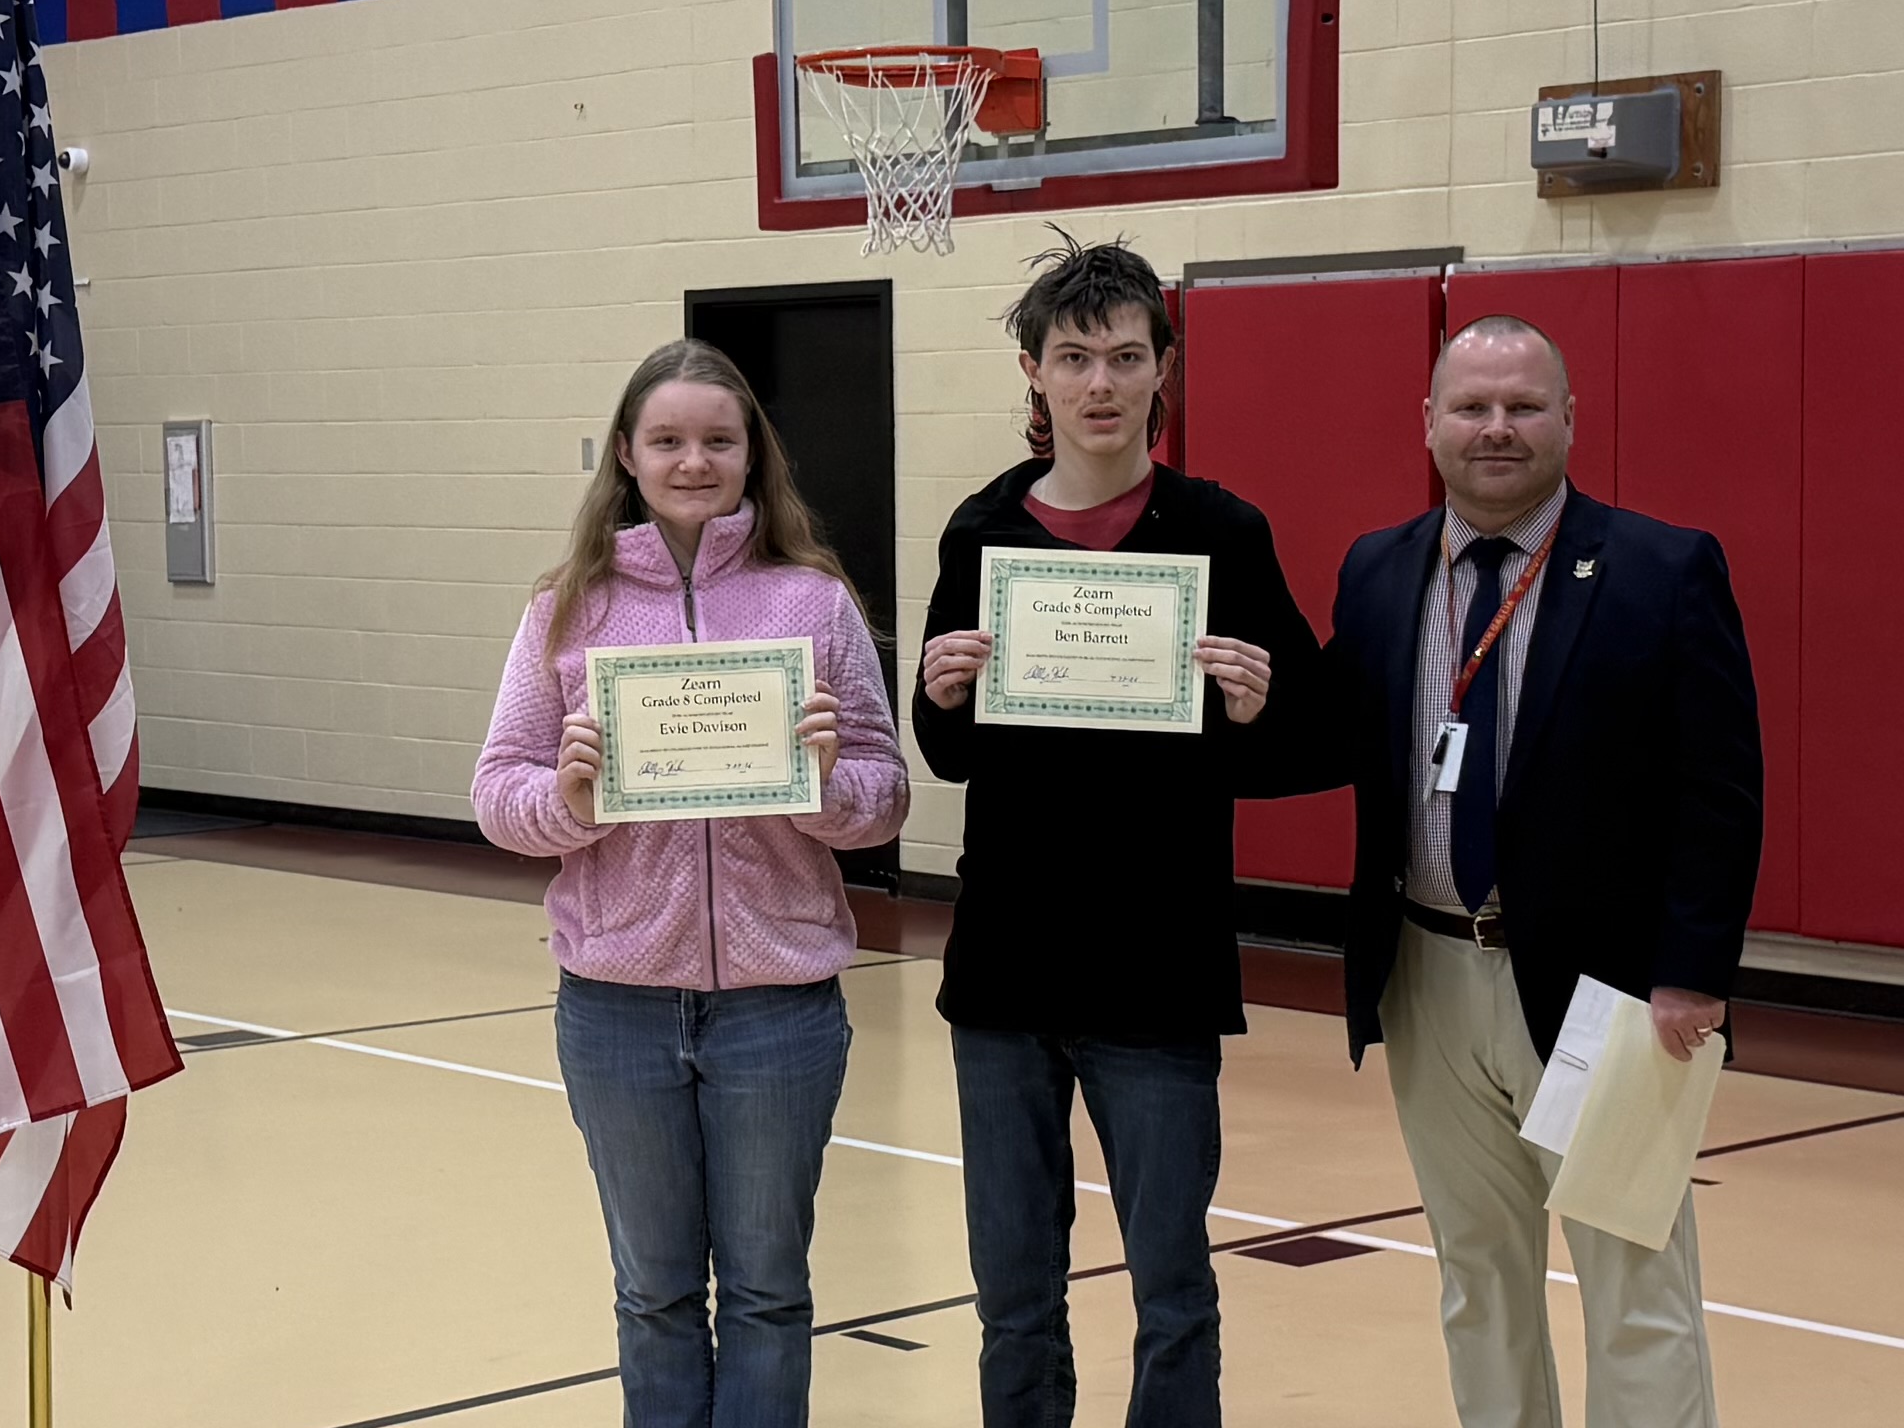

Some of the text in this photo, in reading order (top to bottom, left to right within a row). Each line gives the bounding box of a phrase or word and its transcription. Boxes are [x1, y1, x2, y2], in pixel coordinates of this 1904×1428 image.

[1032, 600, 1152, 619] Grade 8 Completed
[1055, 629, 1129, 645] Ben Barrett
[641, 691, 761, 708] Grade 8 Completed
[659, 720, 747, 735] Evie Davison
